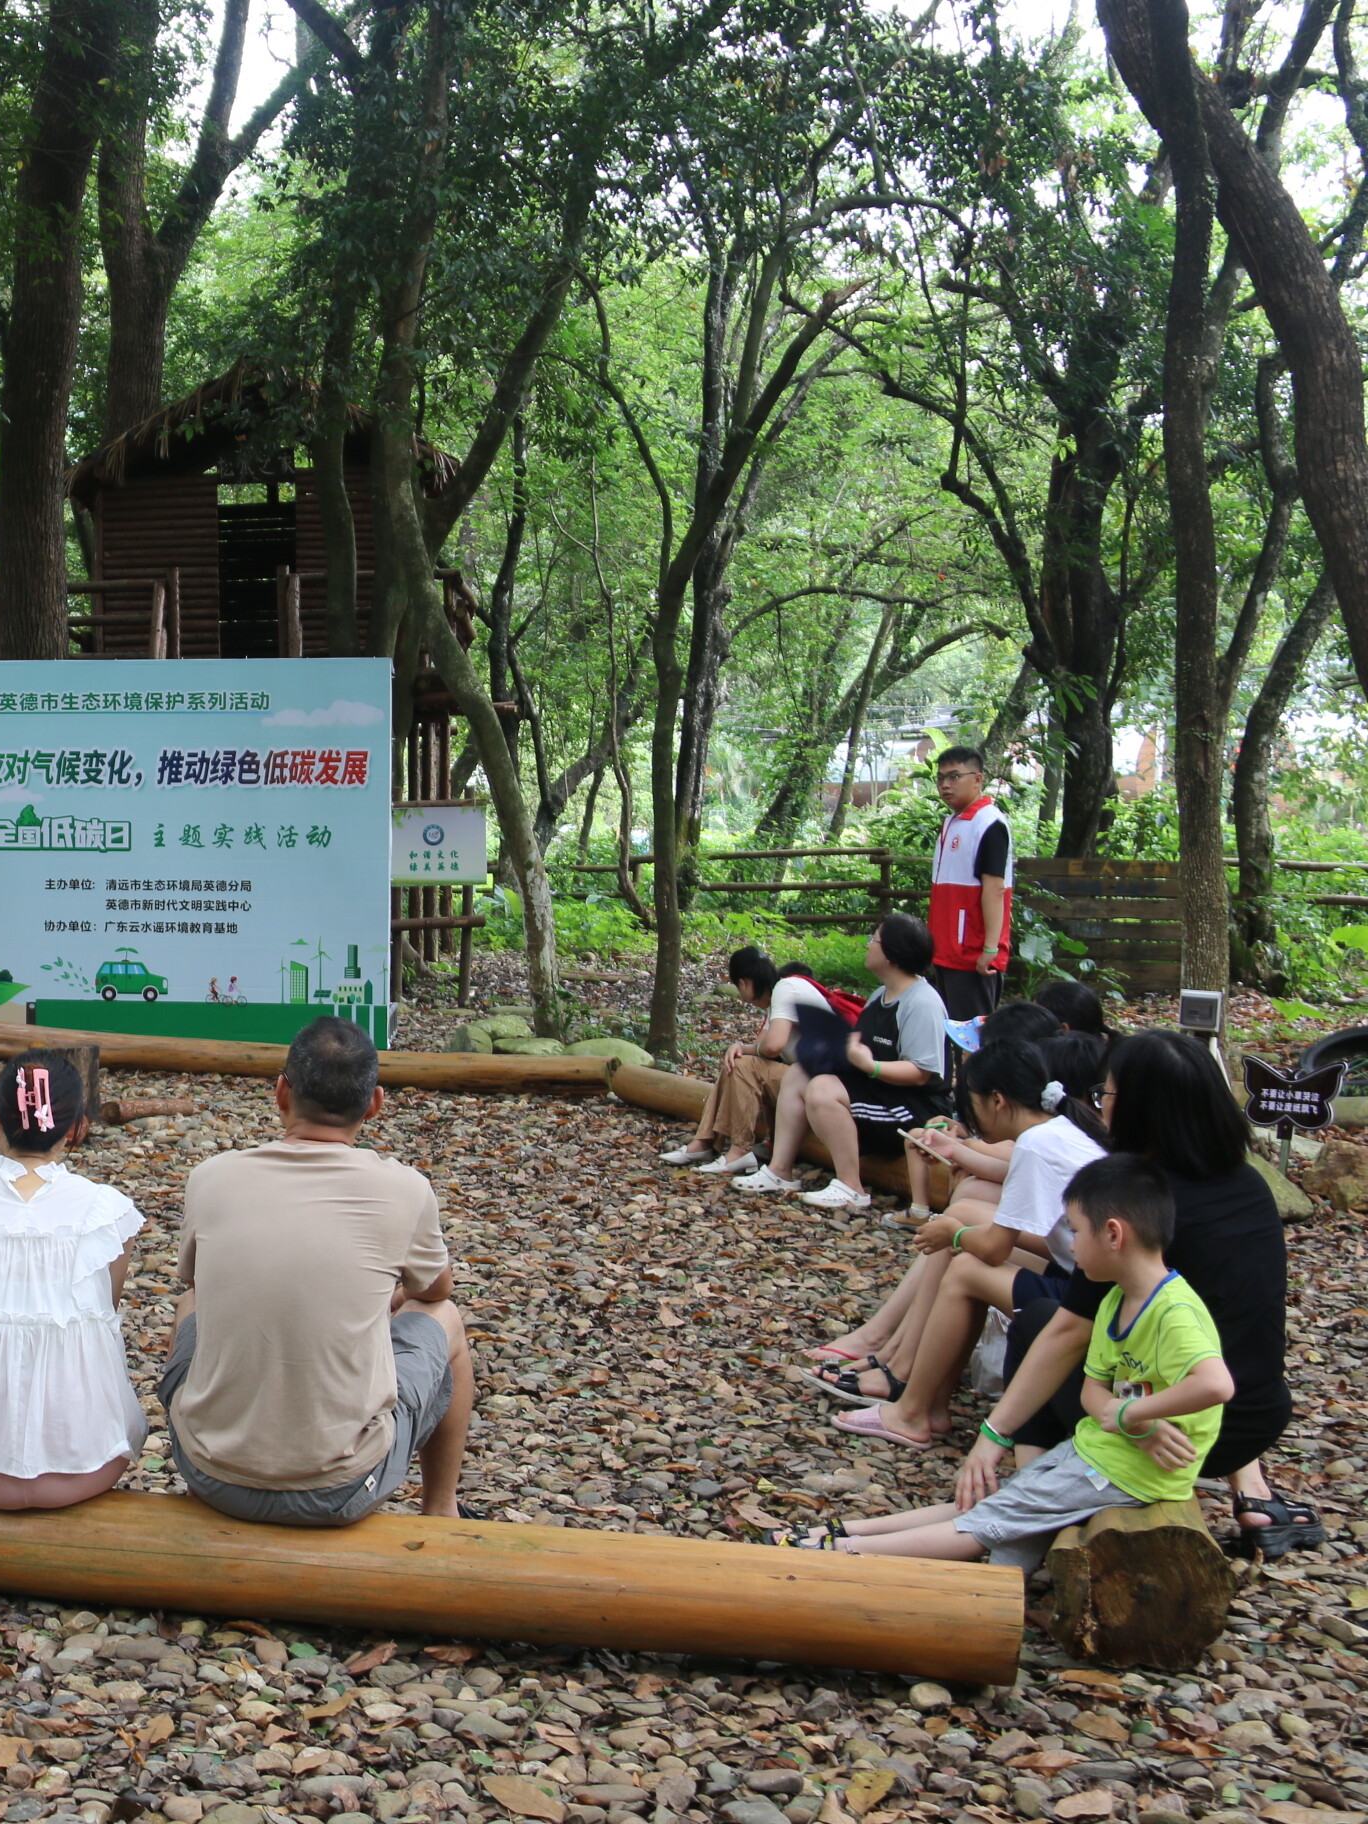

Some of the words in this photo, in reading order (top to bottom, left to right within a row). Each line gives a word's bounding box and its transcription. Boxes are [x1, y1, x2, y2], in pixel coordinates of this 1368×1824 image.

[152, 822, 333, 850] 主题实践活动
[105, 879, 252, 892] 清远市生态环境局英德分局
[105, 898, 252, 912] 英德市新时代文明实践中心
[104, 921, 238, 934] 广东云水谣环境教育基地
[1261, 1088, 1320, 1102] 不要让小草哭泣
